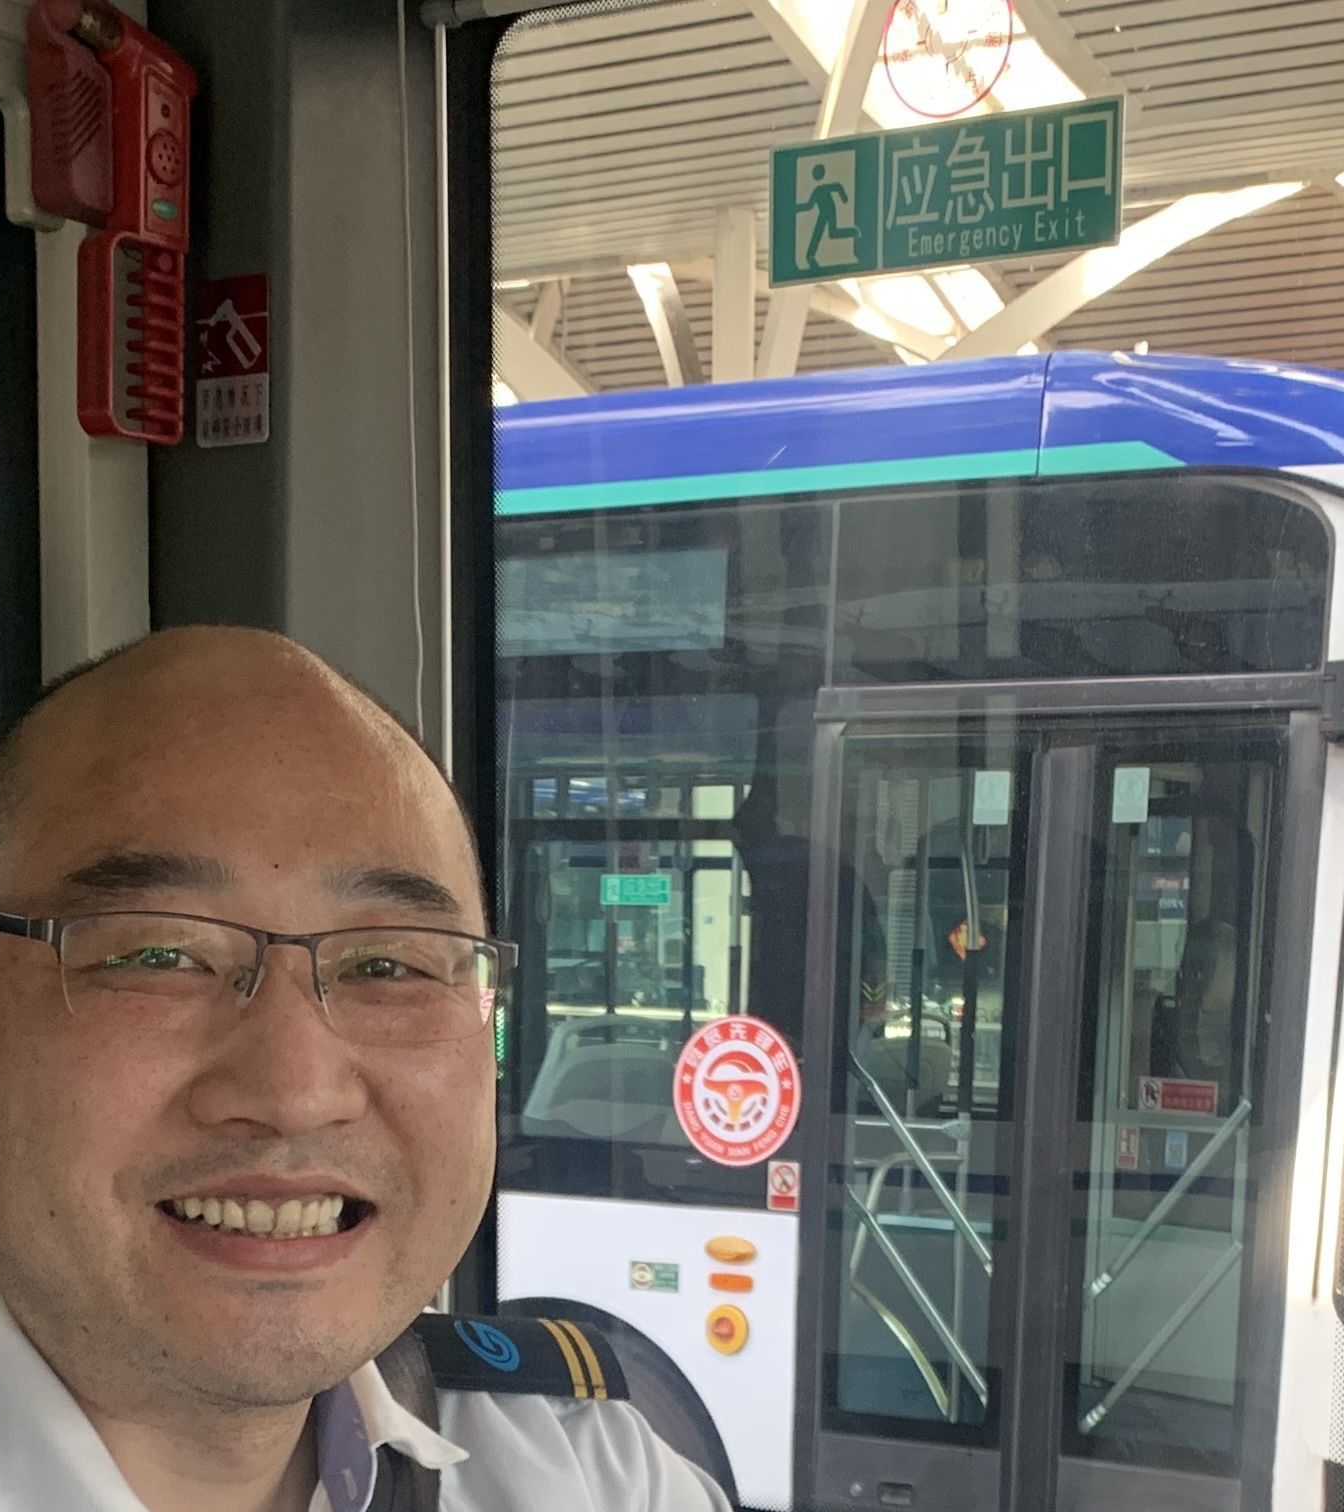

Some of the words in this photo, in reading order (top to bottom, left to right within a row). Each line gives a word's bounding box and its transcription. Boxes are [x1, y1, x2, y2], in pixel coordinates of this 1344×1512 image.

[885, 109, 1113, 231] 应急出口
[908, 221, 1023, 258] Emergency
[1034, 208, 1086, 243] Exit
